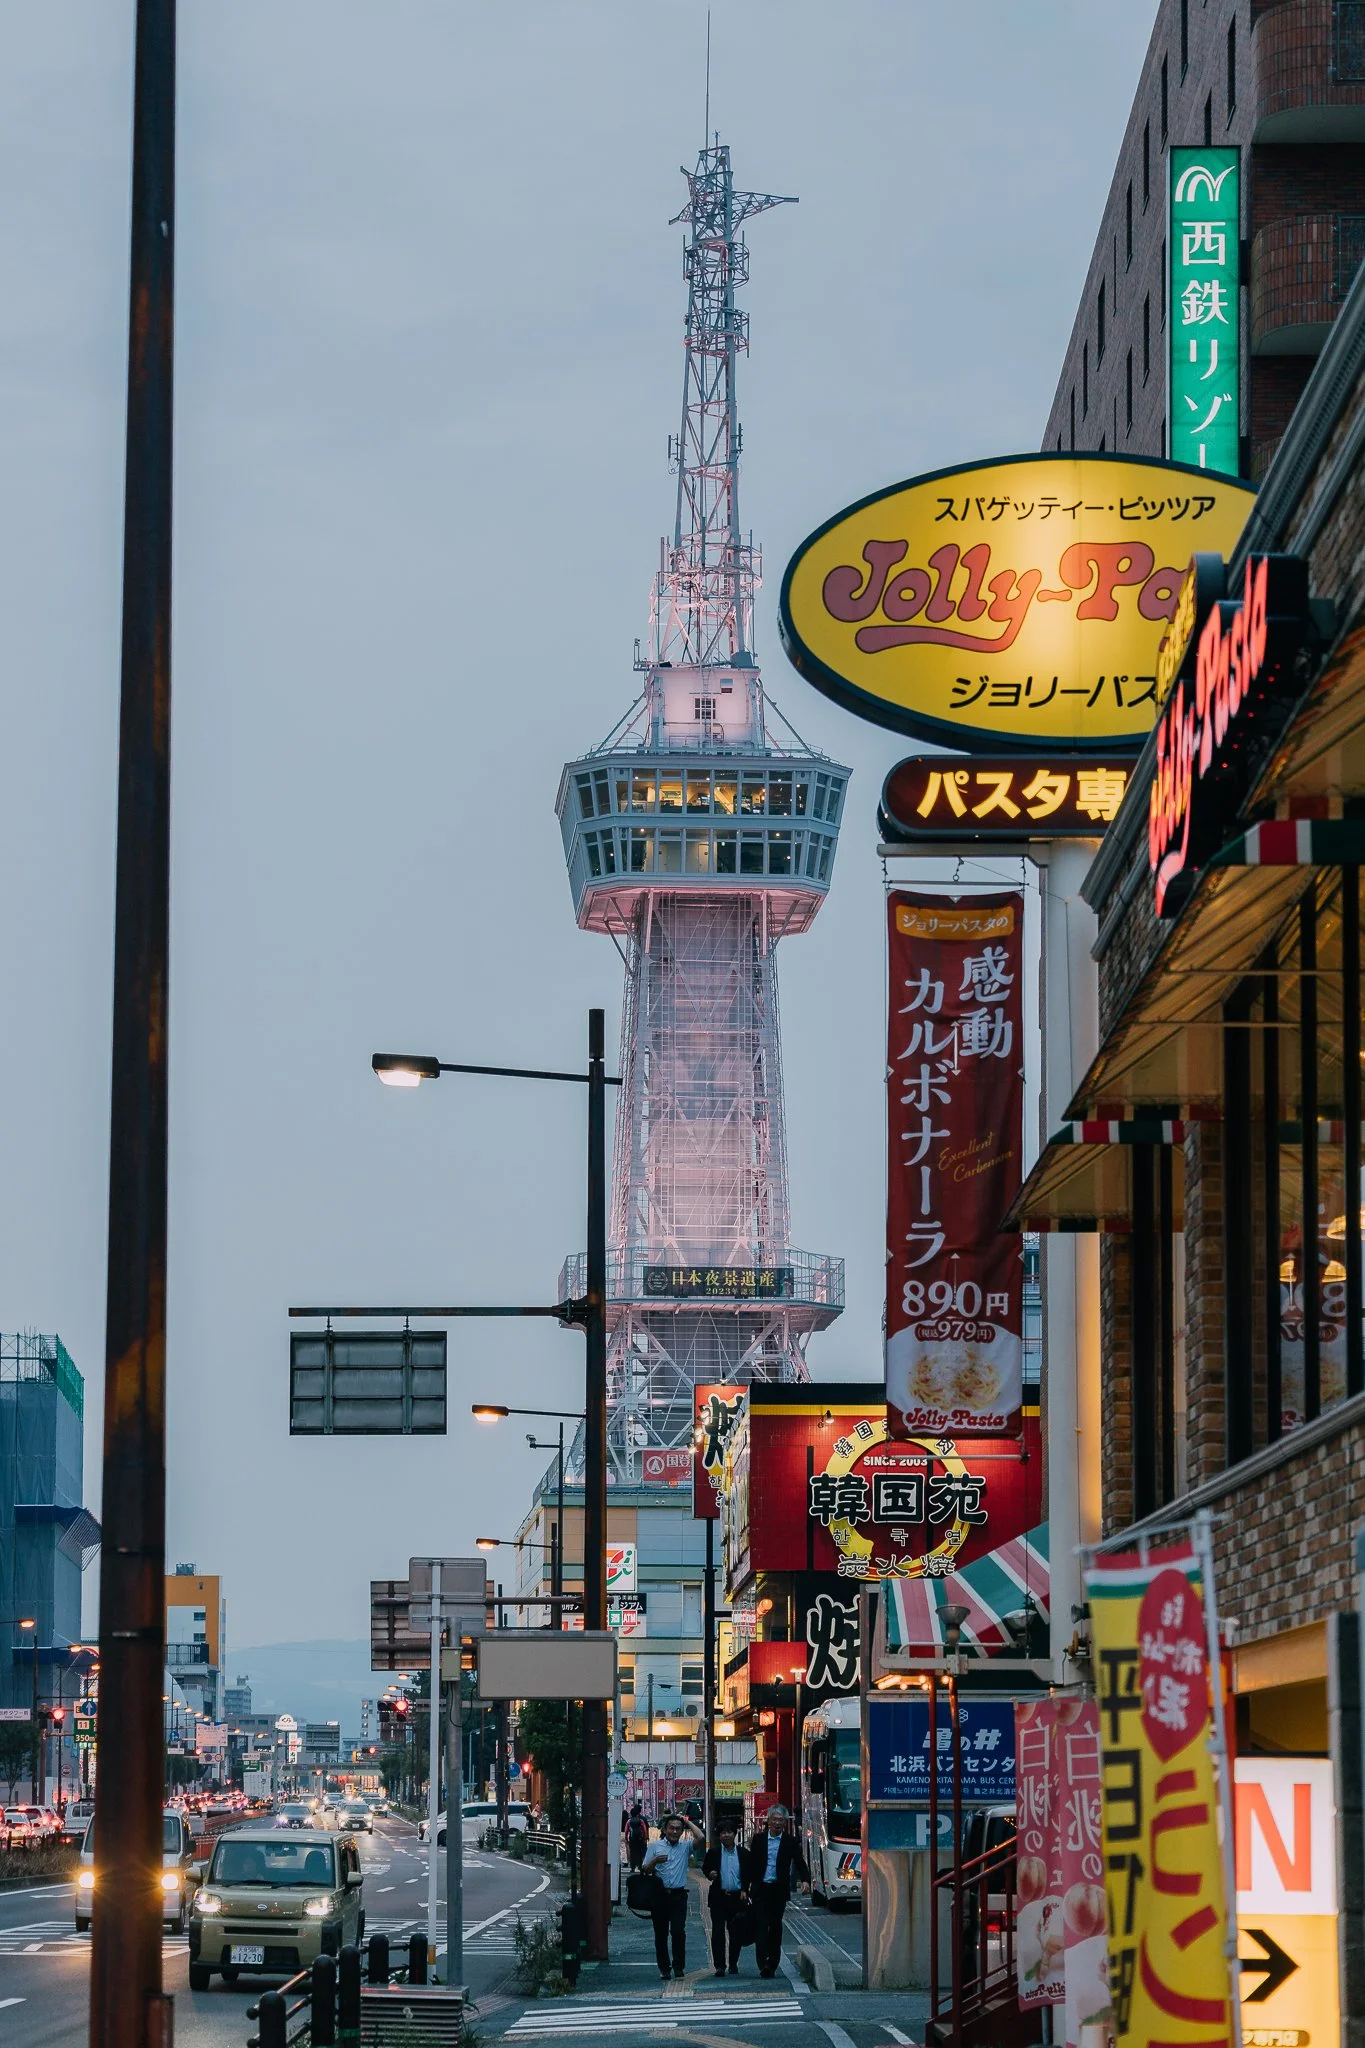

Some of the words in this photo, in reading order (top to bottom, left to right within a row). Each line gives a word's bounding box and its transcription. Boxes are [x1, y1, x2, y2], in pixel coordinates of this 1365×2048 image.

[902, 914, 1008, 933] ジョリーパスタの
[959, 945, 1014, 1060] 感動
[897, 967, 955, 1269] カルボナーラ
[672, 1270, 775, 1287] 日本夜景遺産
[902, 1280, 1009, 1318] 890円
[905, 1408, 1006, 1430] Jolly-Pasta
[863, 1456, 896, 1466] SINCE
[809, 1472, 989, 1526] 韓国苑
[837, 1553, 956, 1577] 炭火焼
[623, 1613, 636, 1623] ATM
[980, 1776, 996, 1784] BUS
[916, 1814, 952, 1846] P
[238, 1953, 263, 1963] 12-30
